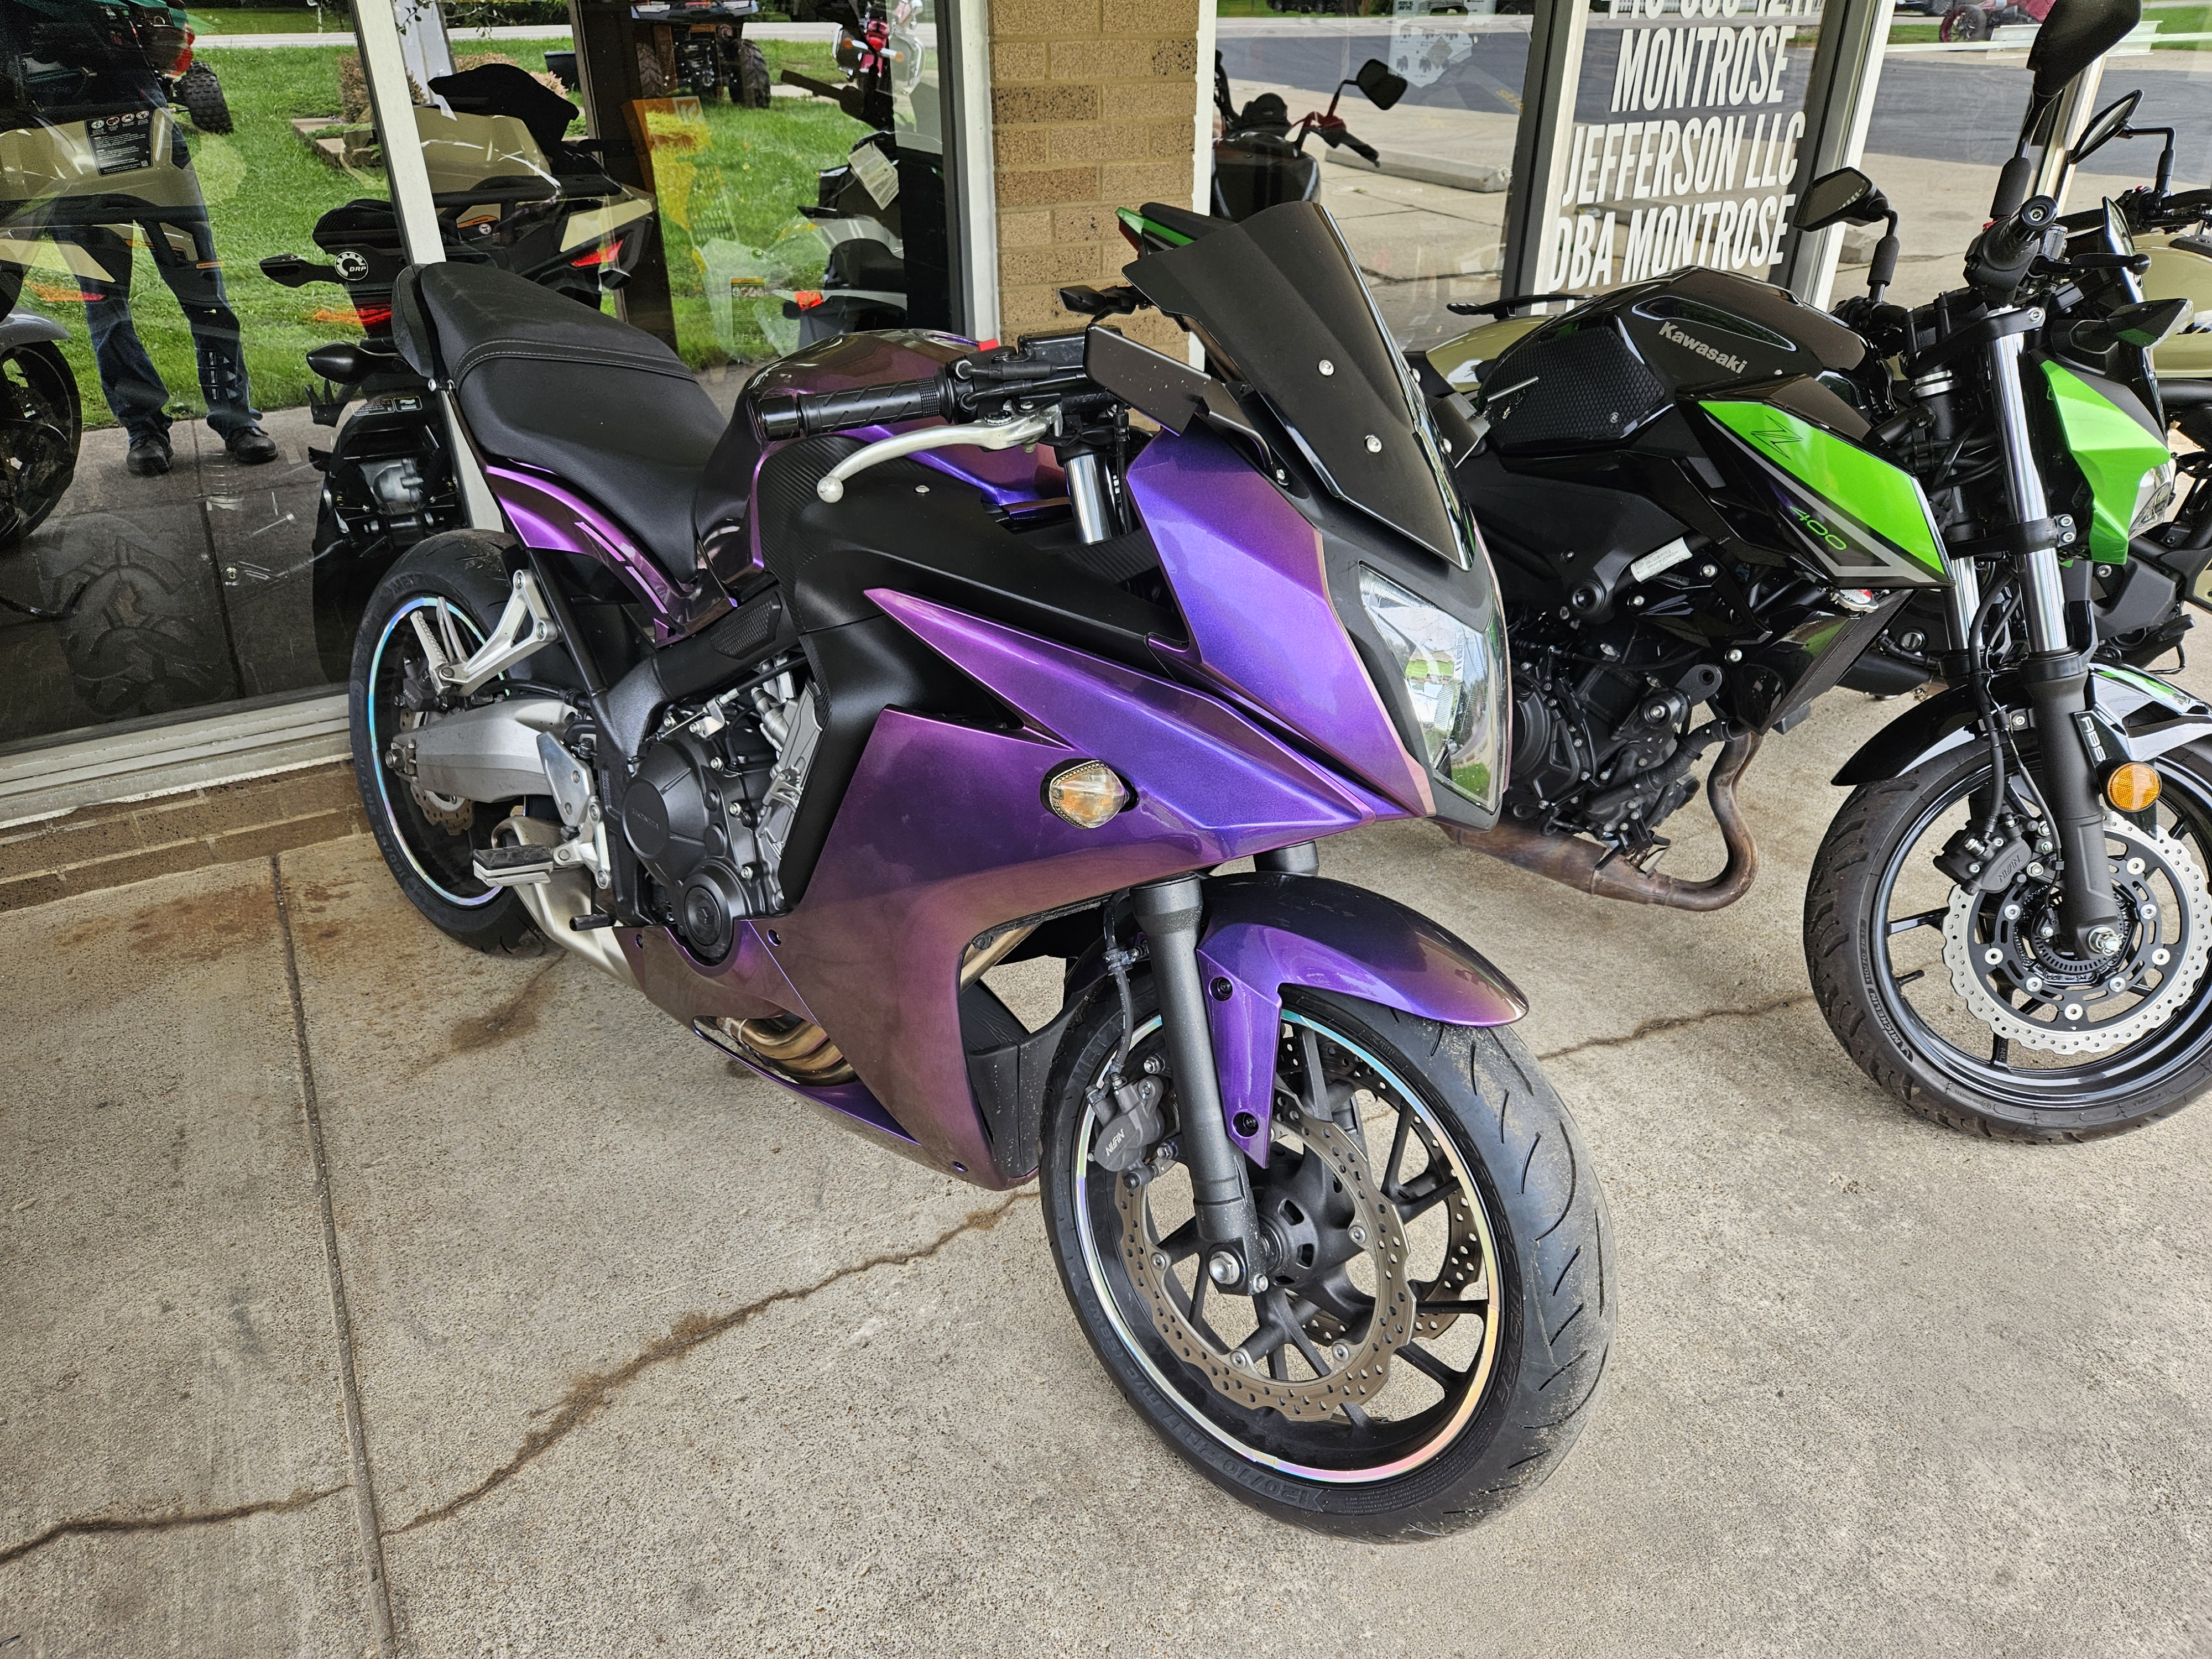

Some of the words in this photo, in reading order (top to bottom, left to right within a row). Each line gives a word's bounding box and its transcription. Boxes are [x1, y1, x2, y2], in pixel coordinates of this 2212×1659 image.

[1610, 25, 1797, 112] MONTROSE
[1562, 114, 1746, 206] JEFFERSON
[1744, 111, 1806, 189] LLC
[1549, 211, 1615, 292] DBA
[1621, 194, 1796, 283] MONTROSE
[1658, 321, 1748, 374] Kawasaki
[1789, 505, 1847, 550] 400
[2080, 716, 2106, 762] ABS
[1861, 953, 1871, 983] 110/70
[1870, 993, 1901, 1044] MICHELIN
[1223, 1459, 1306, 1503] 120/70
